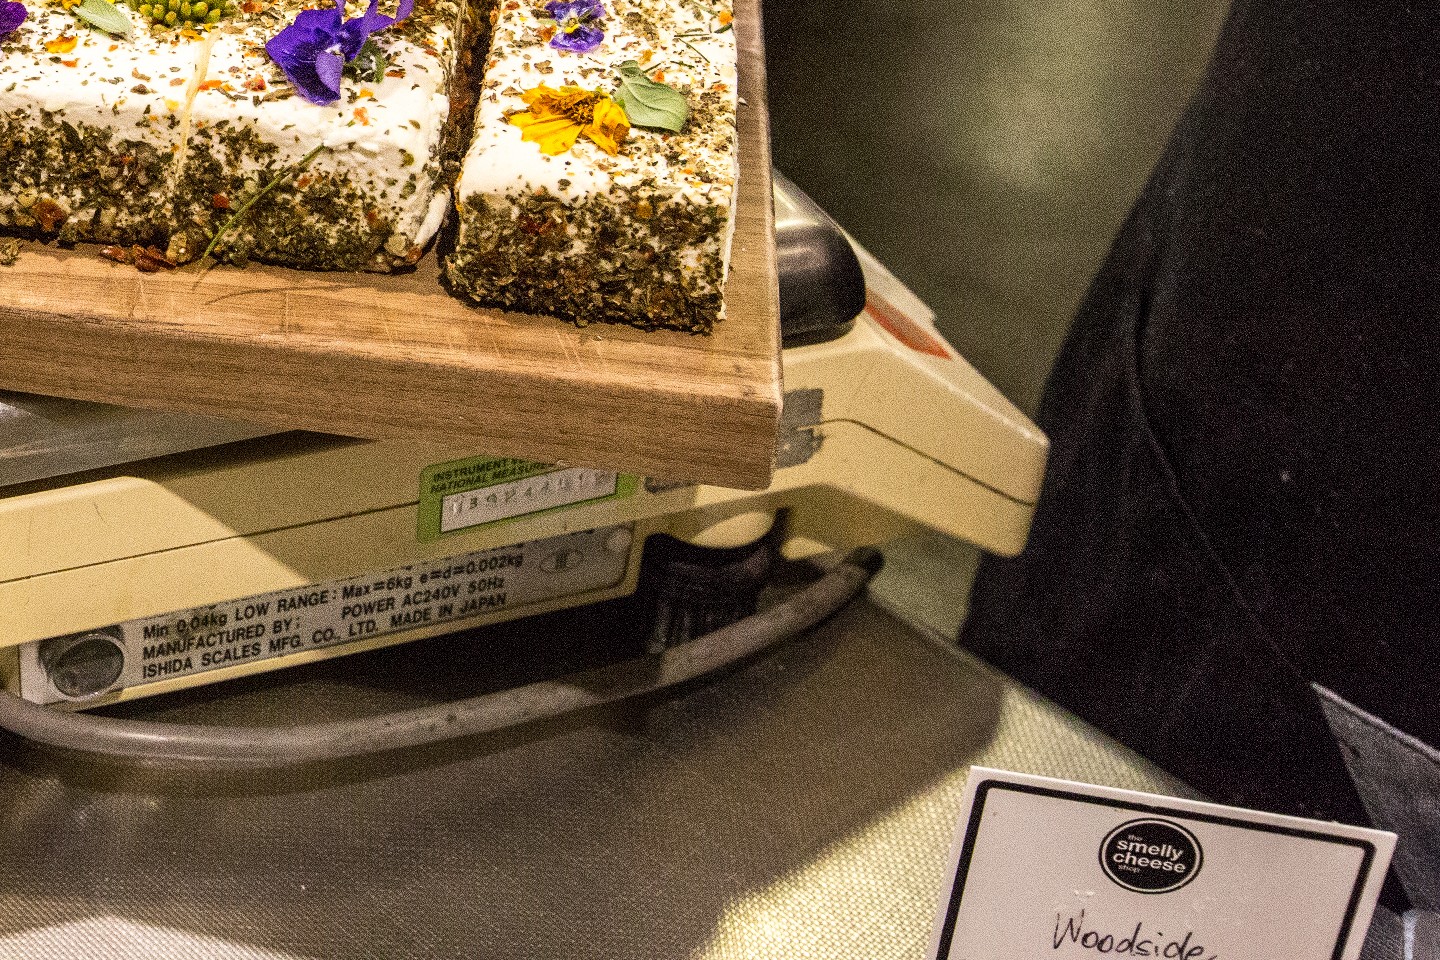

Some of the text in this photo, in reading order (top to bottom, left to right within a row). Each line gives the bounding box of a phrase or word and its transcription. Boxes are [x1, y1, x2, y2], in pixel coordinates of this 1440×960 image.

[433, 459, 507, 481] INSTRUMENT
[431, 474, 487, 493] NATIONAL
[341, 576, 504, 620] POWER AC240V 50Hz
[143, 624, 169, 640] Min
[235, 602, 271, 621] LOW
[142, 658, 193, 679] ISHIDA
[201, 643, 262, 667] SCALES
[268, 635, 304, 654] MFG.
[348, 620, 379, 637] LTD.
[389, 607, 432, 628] MADE
[438, 602, 454, 618] IN
[459, 593, 507, 614] JAPAN
[142, 623, 266, 661] MANUFACTURED
[1127, 834, 1143, 842] the
[1117, 840, 1184, 861] smelly
[1113, 852, 1186, 873] cheese
[1118, 864, 1141, 874] shop
[1054, 909, 1218, 960] Woodside
